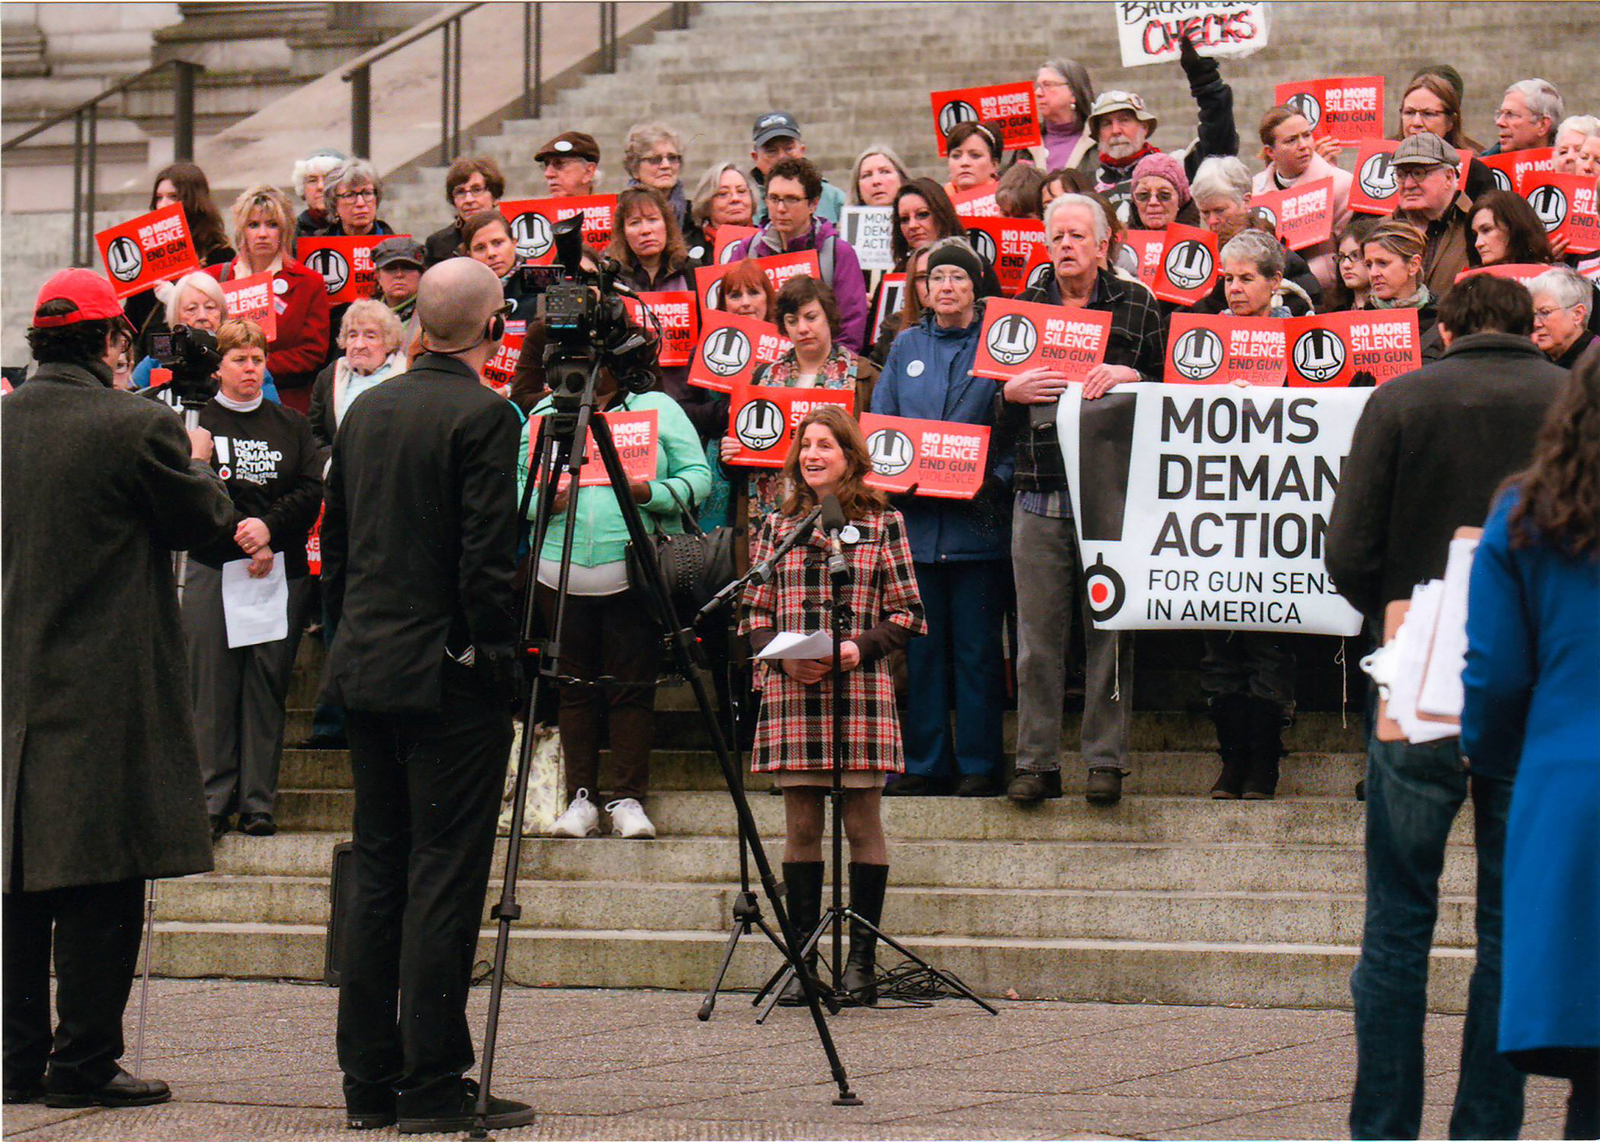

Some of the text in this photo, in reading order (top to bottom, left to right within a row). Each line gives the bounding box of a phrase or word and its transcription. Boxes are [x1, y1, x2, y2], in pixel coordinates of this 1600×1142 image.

[1143, 10, 1257, 54] CHECKS
[981, 92, 1030, 108] NO MORE
[1326, 87, 1376, 99] NO MORE
[981, 102, 1031, 119] SILENCE
[1326, 98, 1376, 111] SILENCE
[1009, 115, 1032, 127] GUN
[1326, 111, 1376, 123] END GUN
[1516, 161, 1554, 174] NO MO
[1281, 187, 1328, 209] NO MORE
[1575, 188, 1592, 200] NO
[557, 206, 610, 220] NO MORE
[1281, 199, 1328, 222] SILENCE
[1572, 200, 1598, 215] SILE
[865, 213, 891, 224] MOM
[1281, 212, 1325, 231] END GUN
[1570, 215, 1594, 228] END
[138, 215, 182, 240] NO MORE
[864, 225, 891, 236] DEM
[142, 225, 185, 251] SILENCE
[587, 231, 611, 244] GUN
[863, 238, 889, 249] ACTI
[1002, 230, 1046, 243] NO MOR
[146, 240, 187, 262] END GUN
[354, 247, 370, 258] NO
[1001, 241, 1033, 255] SILE
[1146, 242, 1163, 254] NO
[1001, 256, 1025, 268] END
[355, 272, 373, 283] EN
[775, 262, 811, 279] MORE
[225, 283, 268, 306] NO MORE
[654, 303, 689, 316] MORE
[665, 328, 690, 341] GUN
[1046, 319, 1103, 336] NO MORE
[1350, 322, 1411, 337] NO MORE
[759, 334, 778, 349] NO
[1043, 331, 1101, 350] SILENCE
[1231, 330, 1286, 344] NO MORE
[1352, 334, 1412, 352] SILENCE
[1041, 347, 1096, 363] END GUN
[1229, 342, 1286, 358] SILENCE
[1353, 350, 1413, 365] END GUN
[1228, 359, 1283, 371] END GUN
[484, 368, 507, 383] END
[791, 401, 809, 412] NO
[1160, 396, 1319, 444] MOMS
[613, 421, 650, 435] MORE
[233, 438, 268, 451] MOMS
[614, 433, 651, 448] ENCE
[922, 432, 981, 447] NO MORE
[235, 448, 282, 461] DEMAND
[622, 449, 650, 460] GUN
[920, 444, 980, 460] SILENCE
[236, 458, 275, 472] ACTION
[919, 459, 977, 472] END GUN
[1158, 453, 1350, 502] DEMAN
[1148, 569, 1338, 595] FOR GUN SENS
[1147, 598, 1302, 624] IN AMERICA
